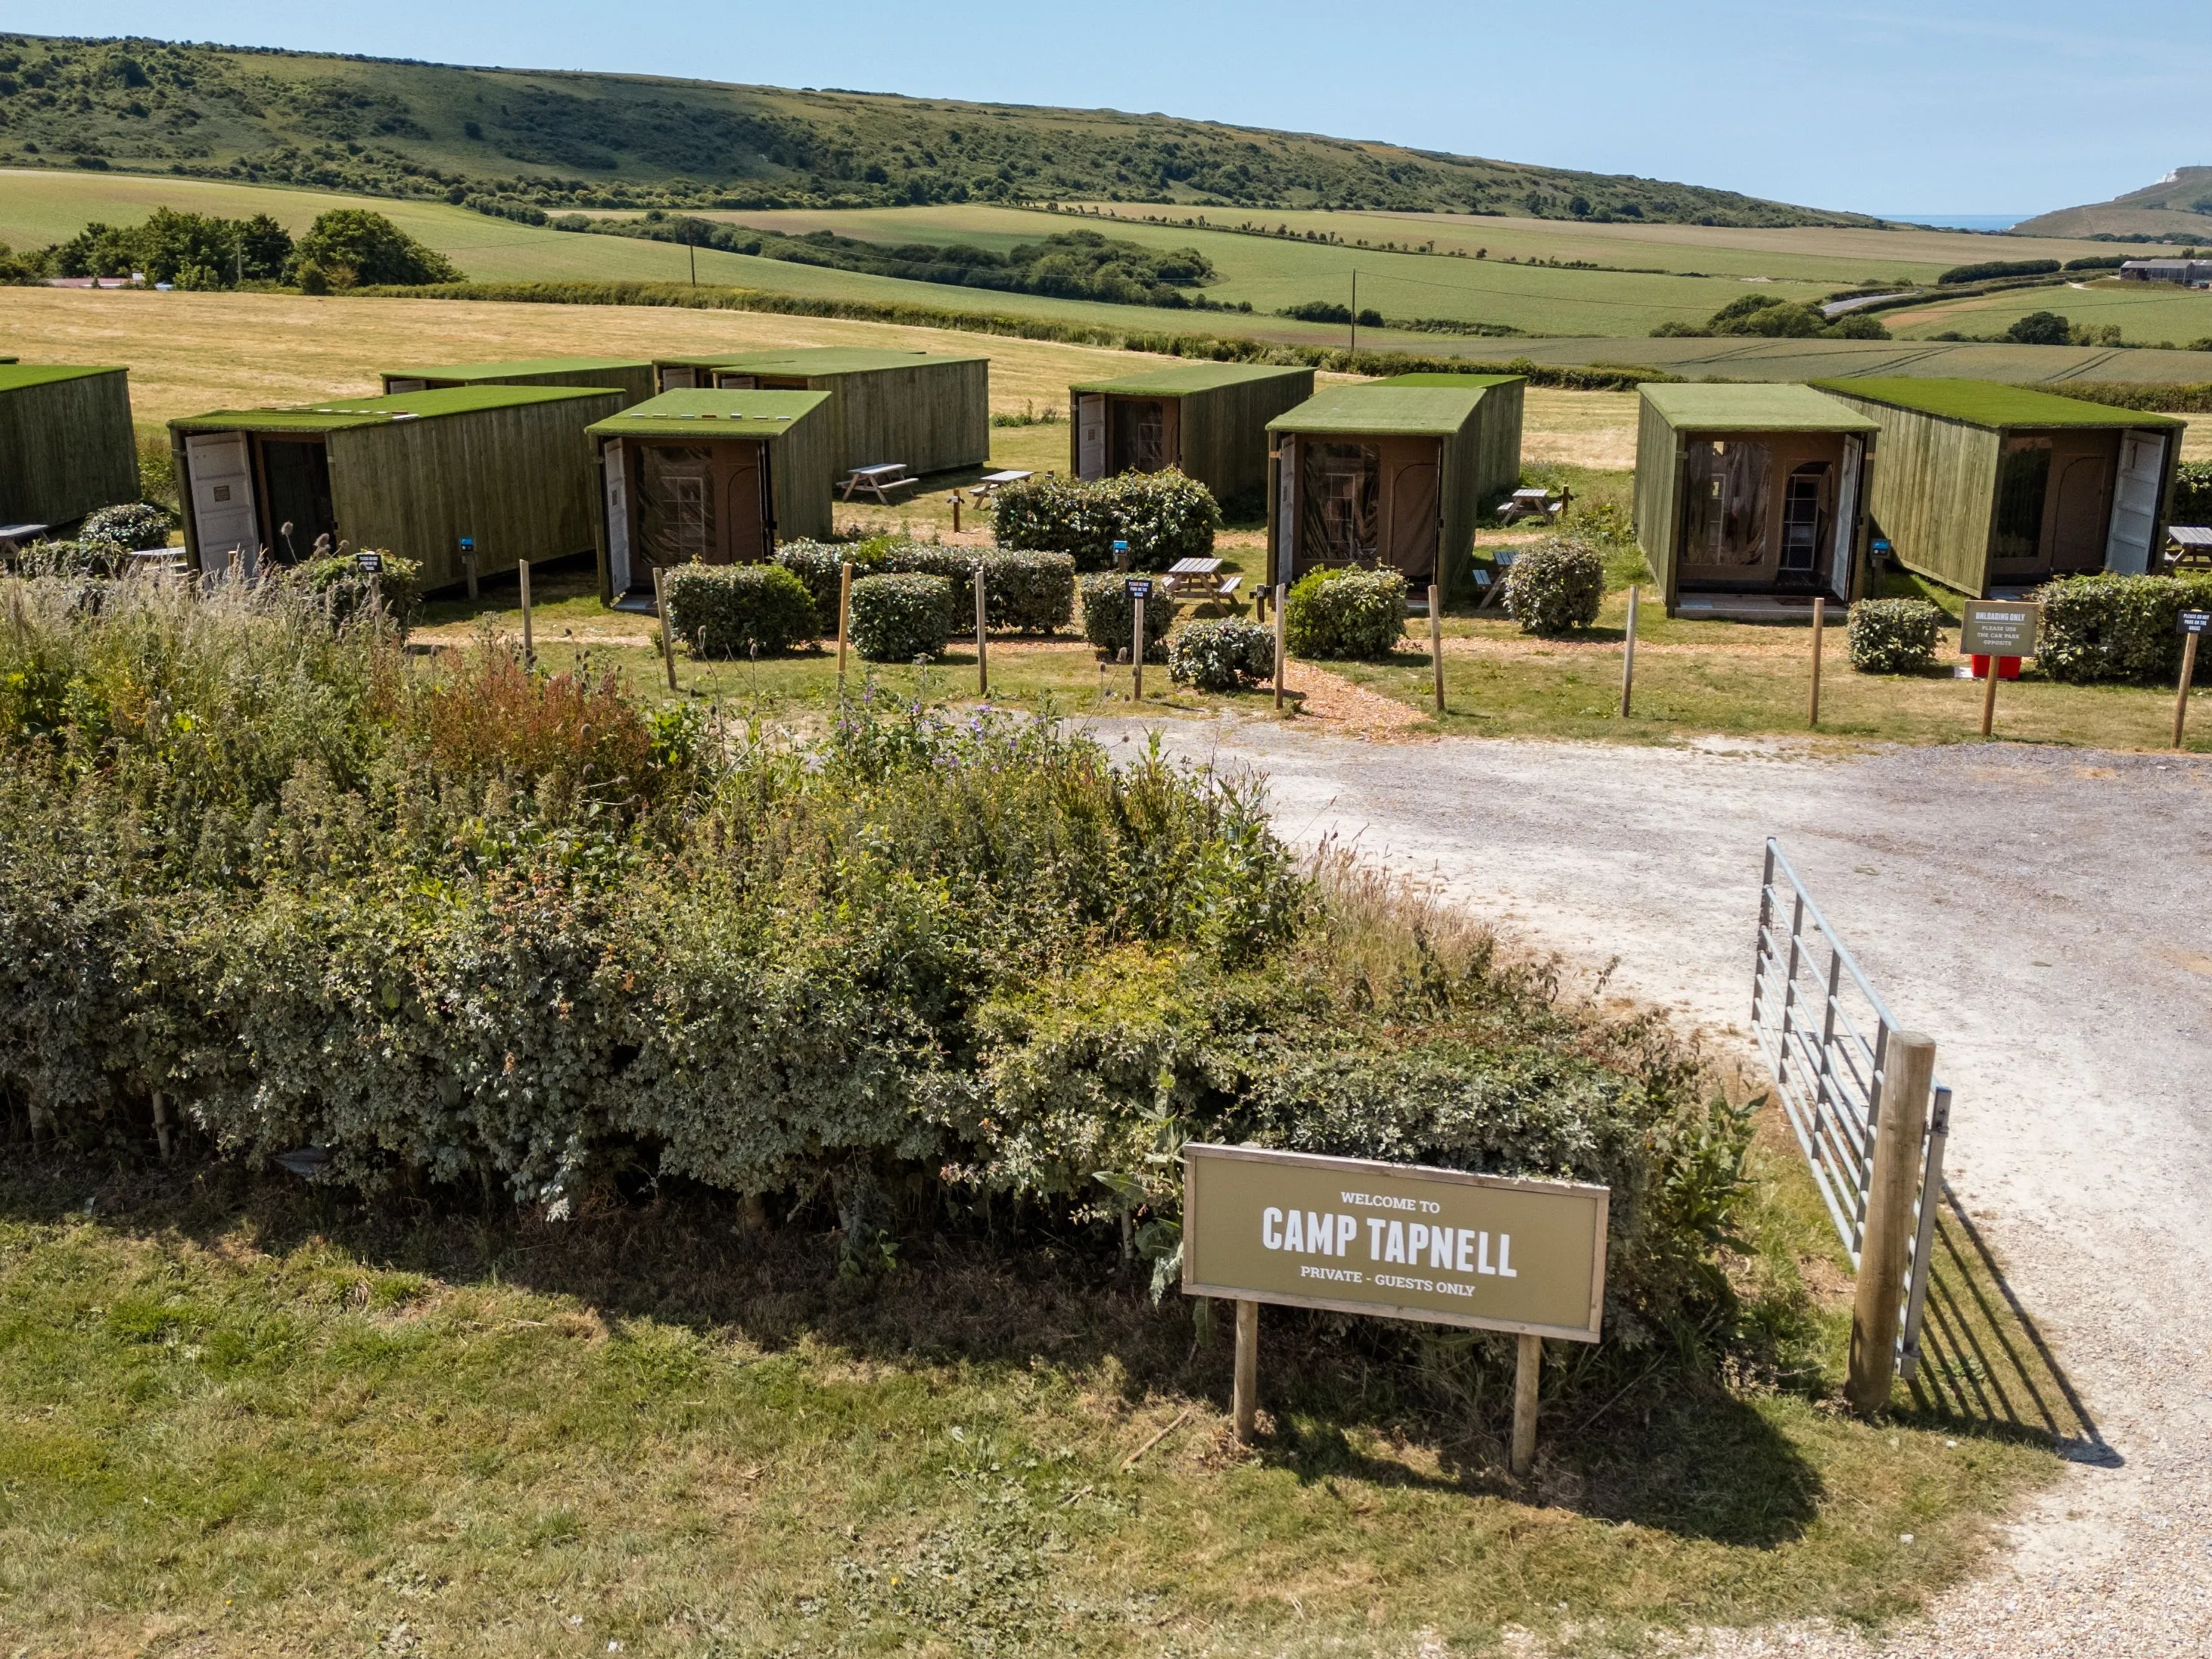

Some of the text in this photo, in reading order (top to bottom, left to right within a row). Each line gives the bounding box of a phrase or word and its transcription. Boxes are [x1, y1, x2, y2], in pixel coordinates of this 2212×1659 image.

[1975, 612, 2026, 621] UNLOADING ONLY
[1340, 1191, 1440, 1213] WELCOME TO
[1262, 1207, 1517, 1278] CAMP TAPNELL
[1300, 1265, 1363, 1284] PRIVATE
[1374, 1274, 1433, 1292] GUESTS
[1436, 1282, 1476, 1297] ONLY
